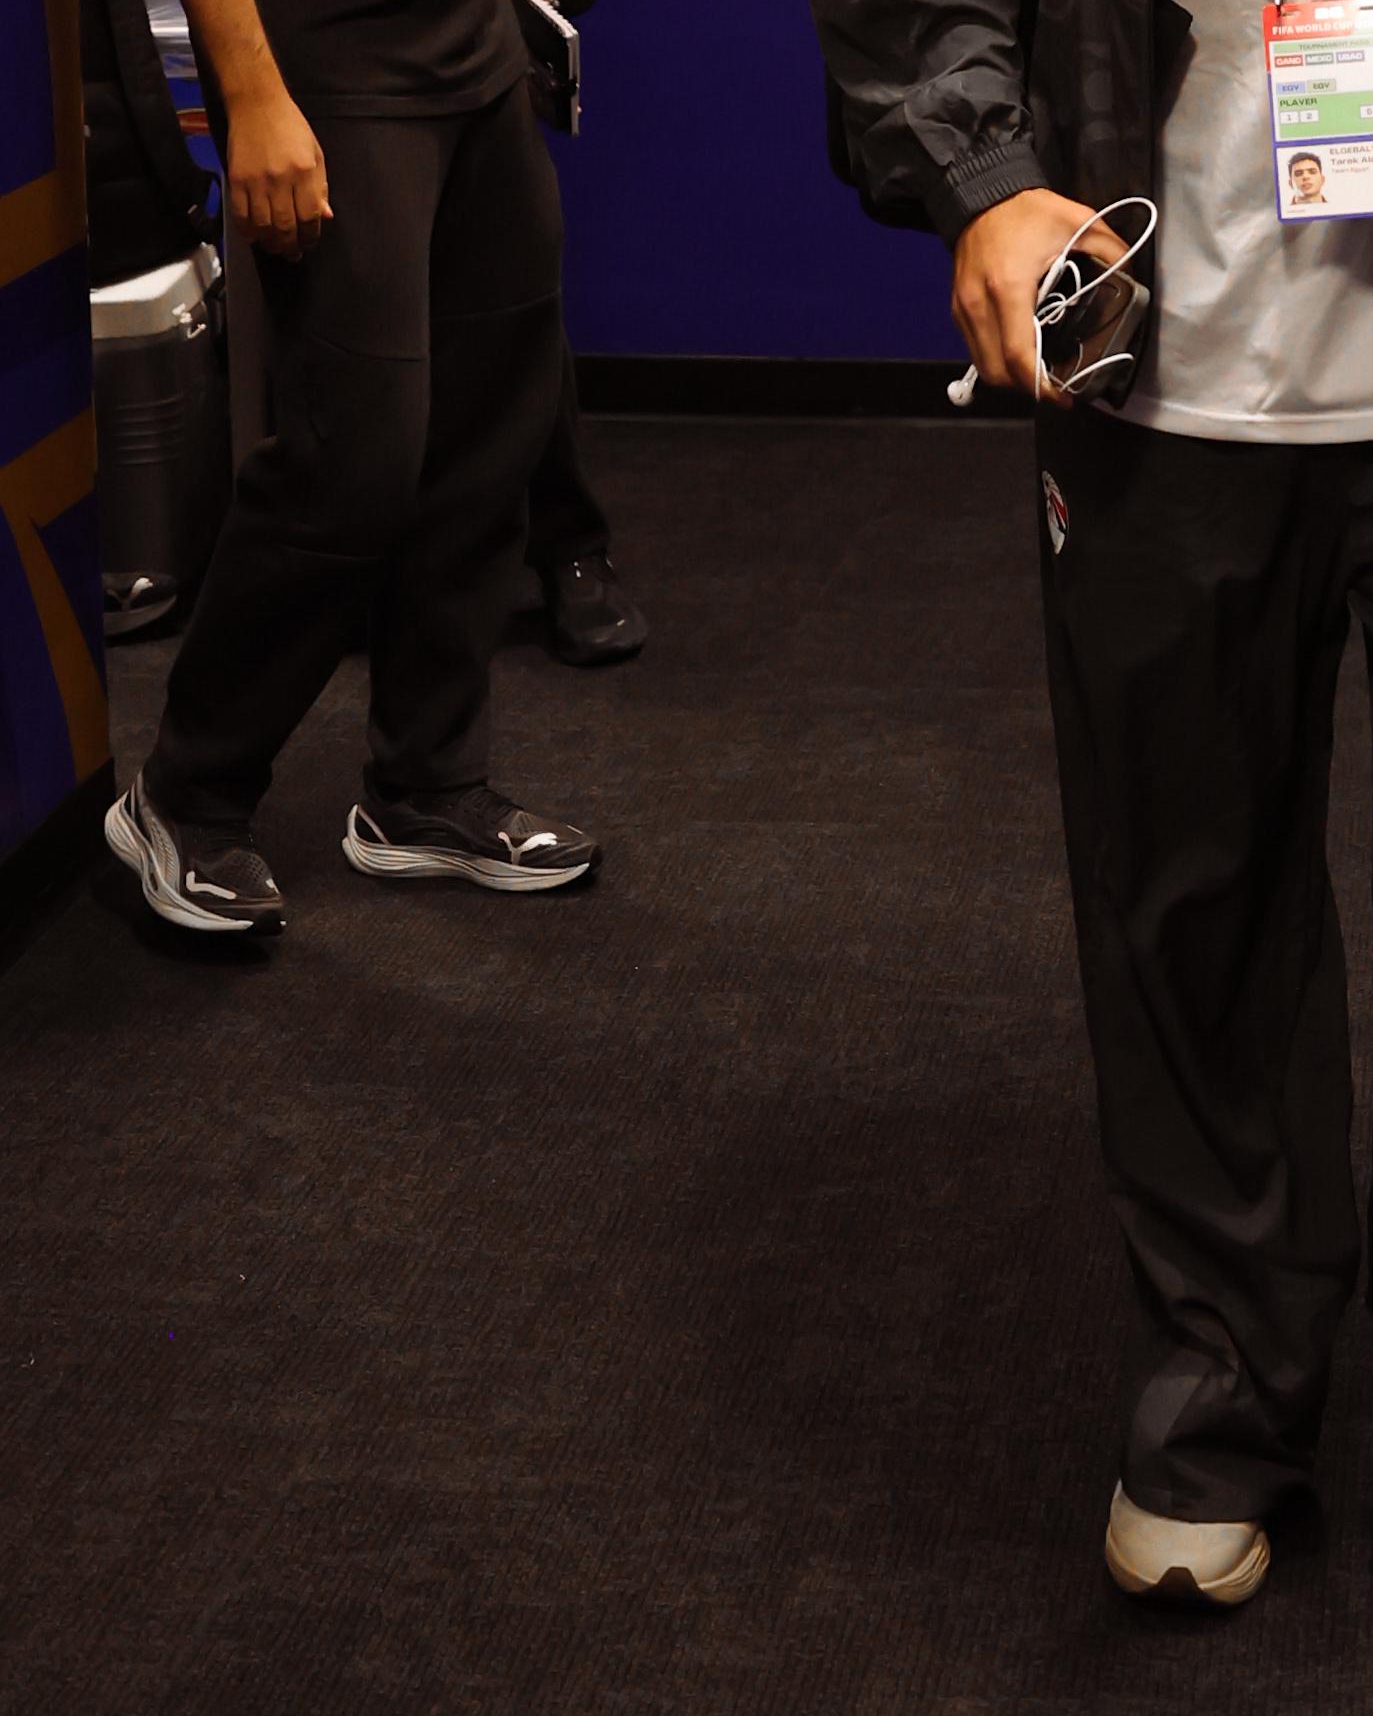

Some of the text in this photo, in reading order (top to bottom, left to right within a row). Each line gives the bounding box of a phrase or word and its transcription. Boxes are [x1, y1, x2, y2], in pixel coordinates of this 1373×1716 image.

[1272, 24, 1294, 35] FIFA
[1295, 22, 1332, 34] WORLD
[1279, 98, 1318, 107] PLAYER
